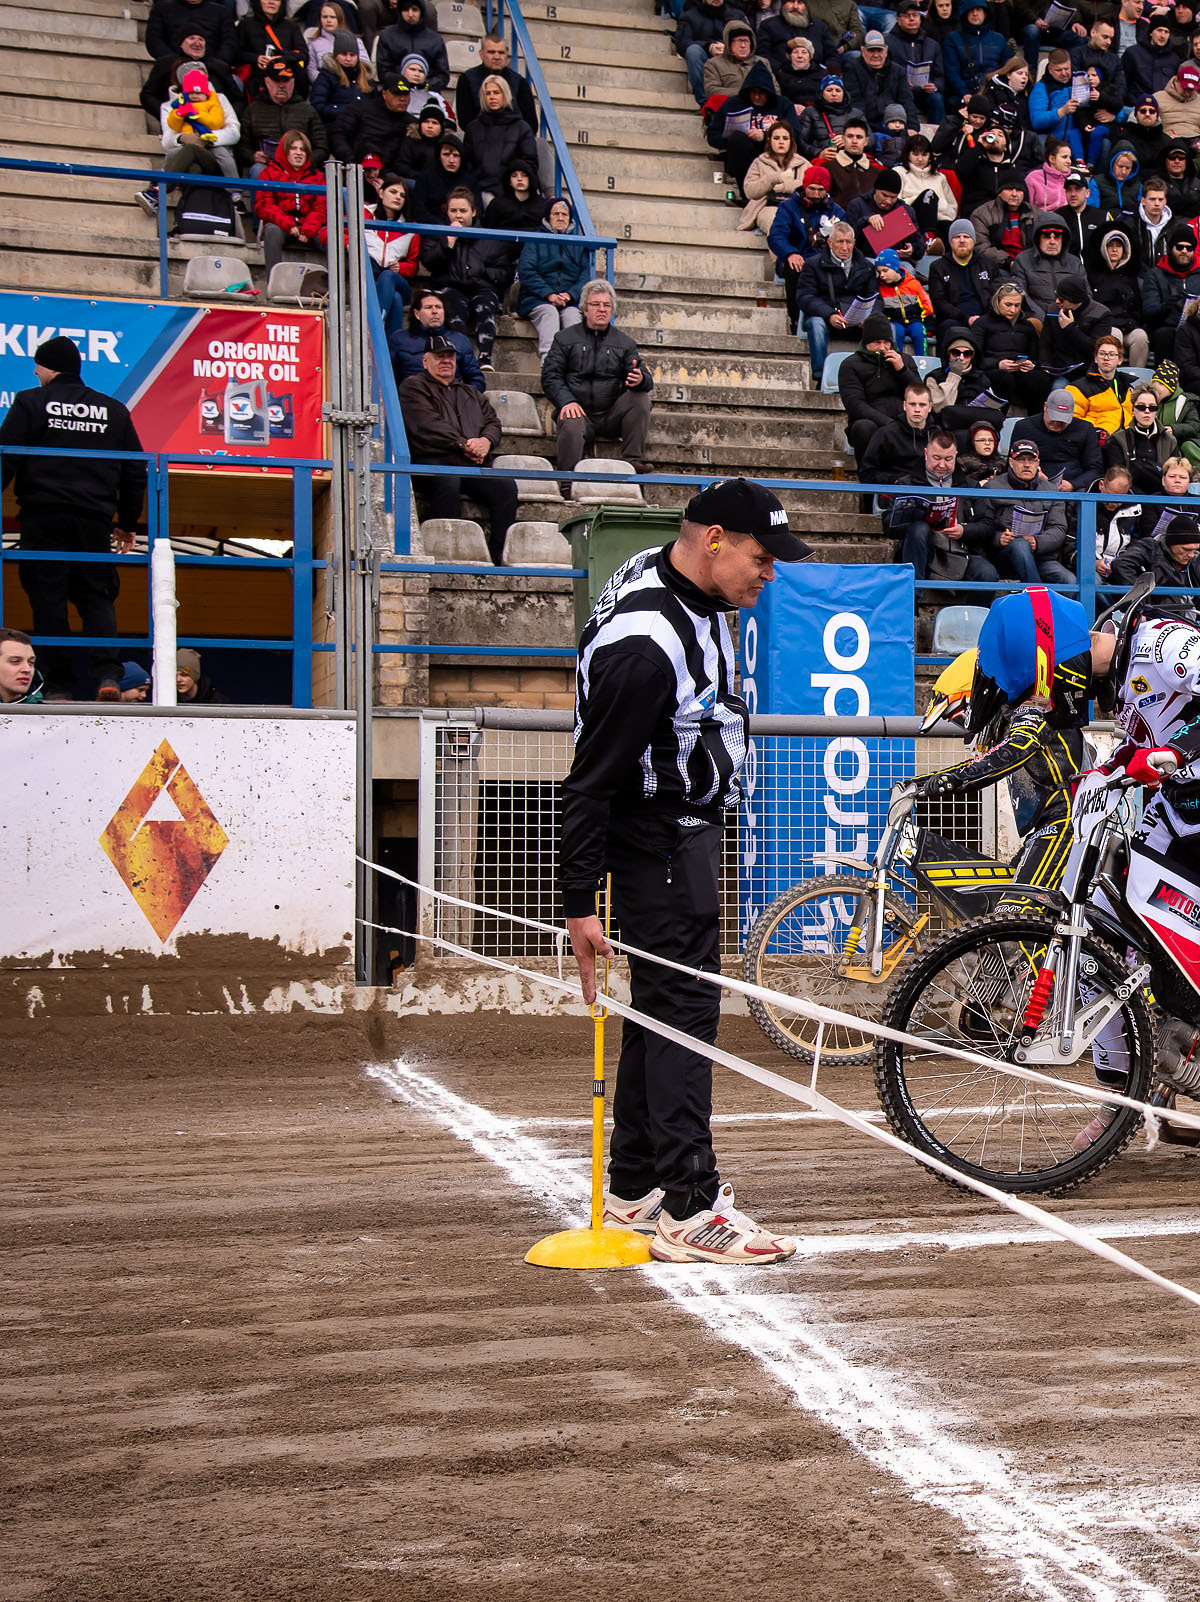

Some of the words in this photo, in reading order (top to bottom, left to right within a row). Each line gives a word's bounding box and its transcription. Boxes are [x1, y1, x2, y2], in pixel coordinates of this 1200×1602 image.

[546, 6, 557, 18] 13
[561, 46, 571, 58] 12
[577, 85, 586, 98] 11
[578, 130, 588, 144] 10
[607, 176, 615, 190] 9
[624, 225, 631, 239] 8
[214, 260, 222, 269] 6
[299, 266, 306, 275] 7
[638, 275, 647, 289] 7
[266, 324, 300, 343] THE
[656, 330, 664, 344] 6
[208, 340, 300, 363] ORIGINAL
[193, 359, 264, 381] MOTOR
[268, 365, 300, 383] OIL
[919, 360, 927, 370] 2
[676, 386, 684, 400] 5
[45, 401, 108, 420] GROM
[48, 418, 108, 434] SECURITY
